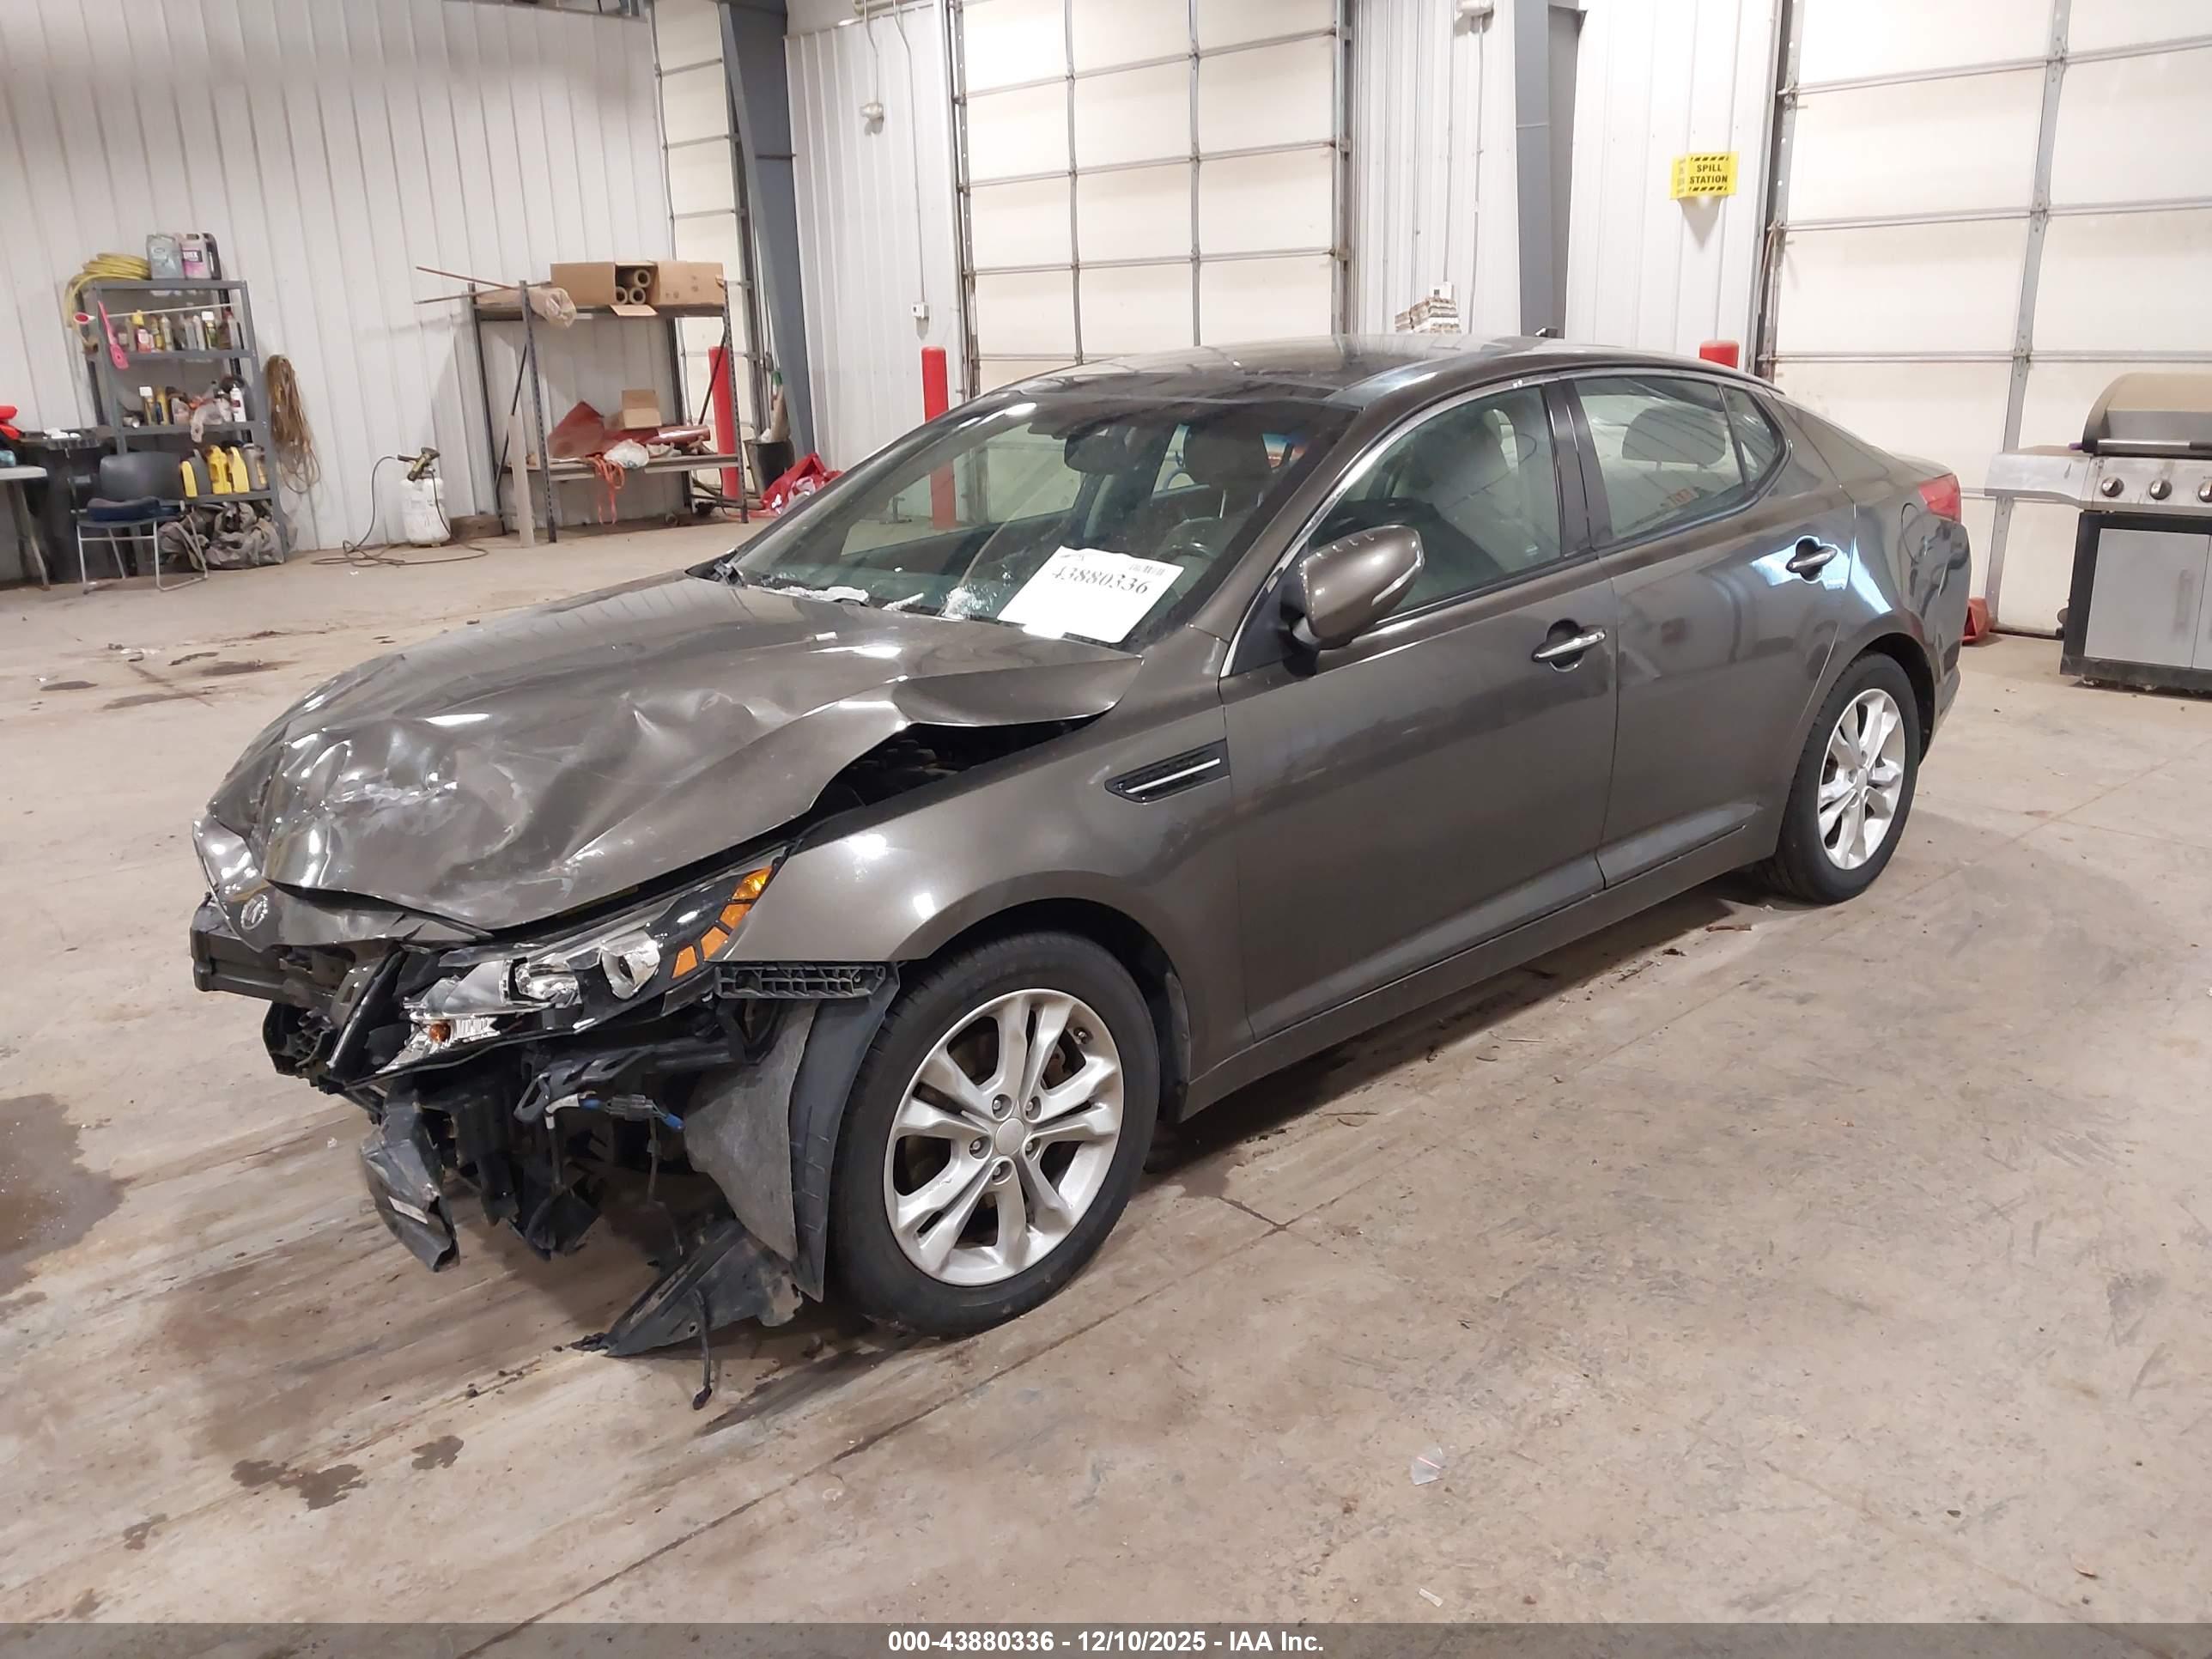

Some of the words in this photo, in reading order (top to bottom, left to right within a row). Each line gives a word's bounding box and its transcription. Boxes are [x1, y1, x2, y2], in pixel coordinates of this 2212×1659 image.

[1697, 163, 1723, 173] SPILL
[1689, 174, 1729, 185] STATION
[1052, 565, 1152, 594] 43880336
